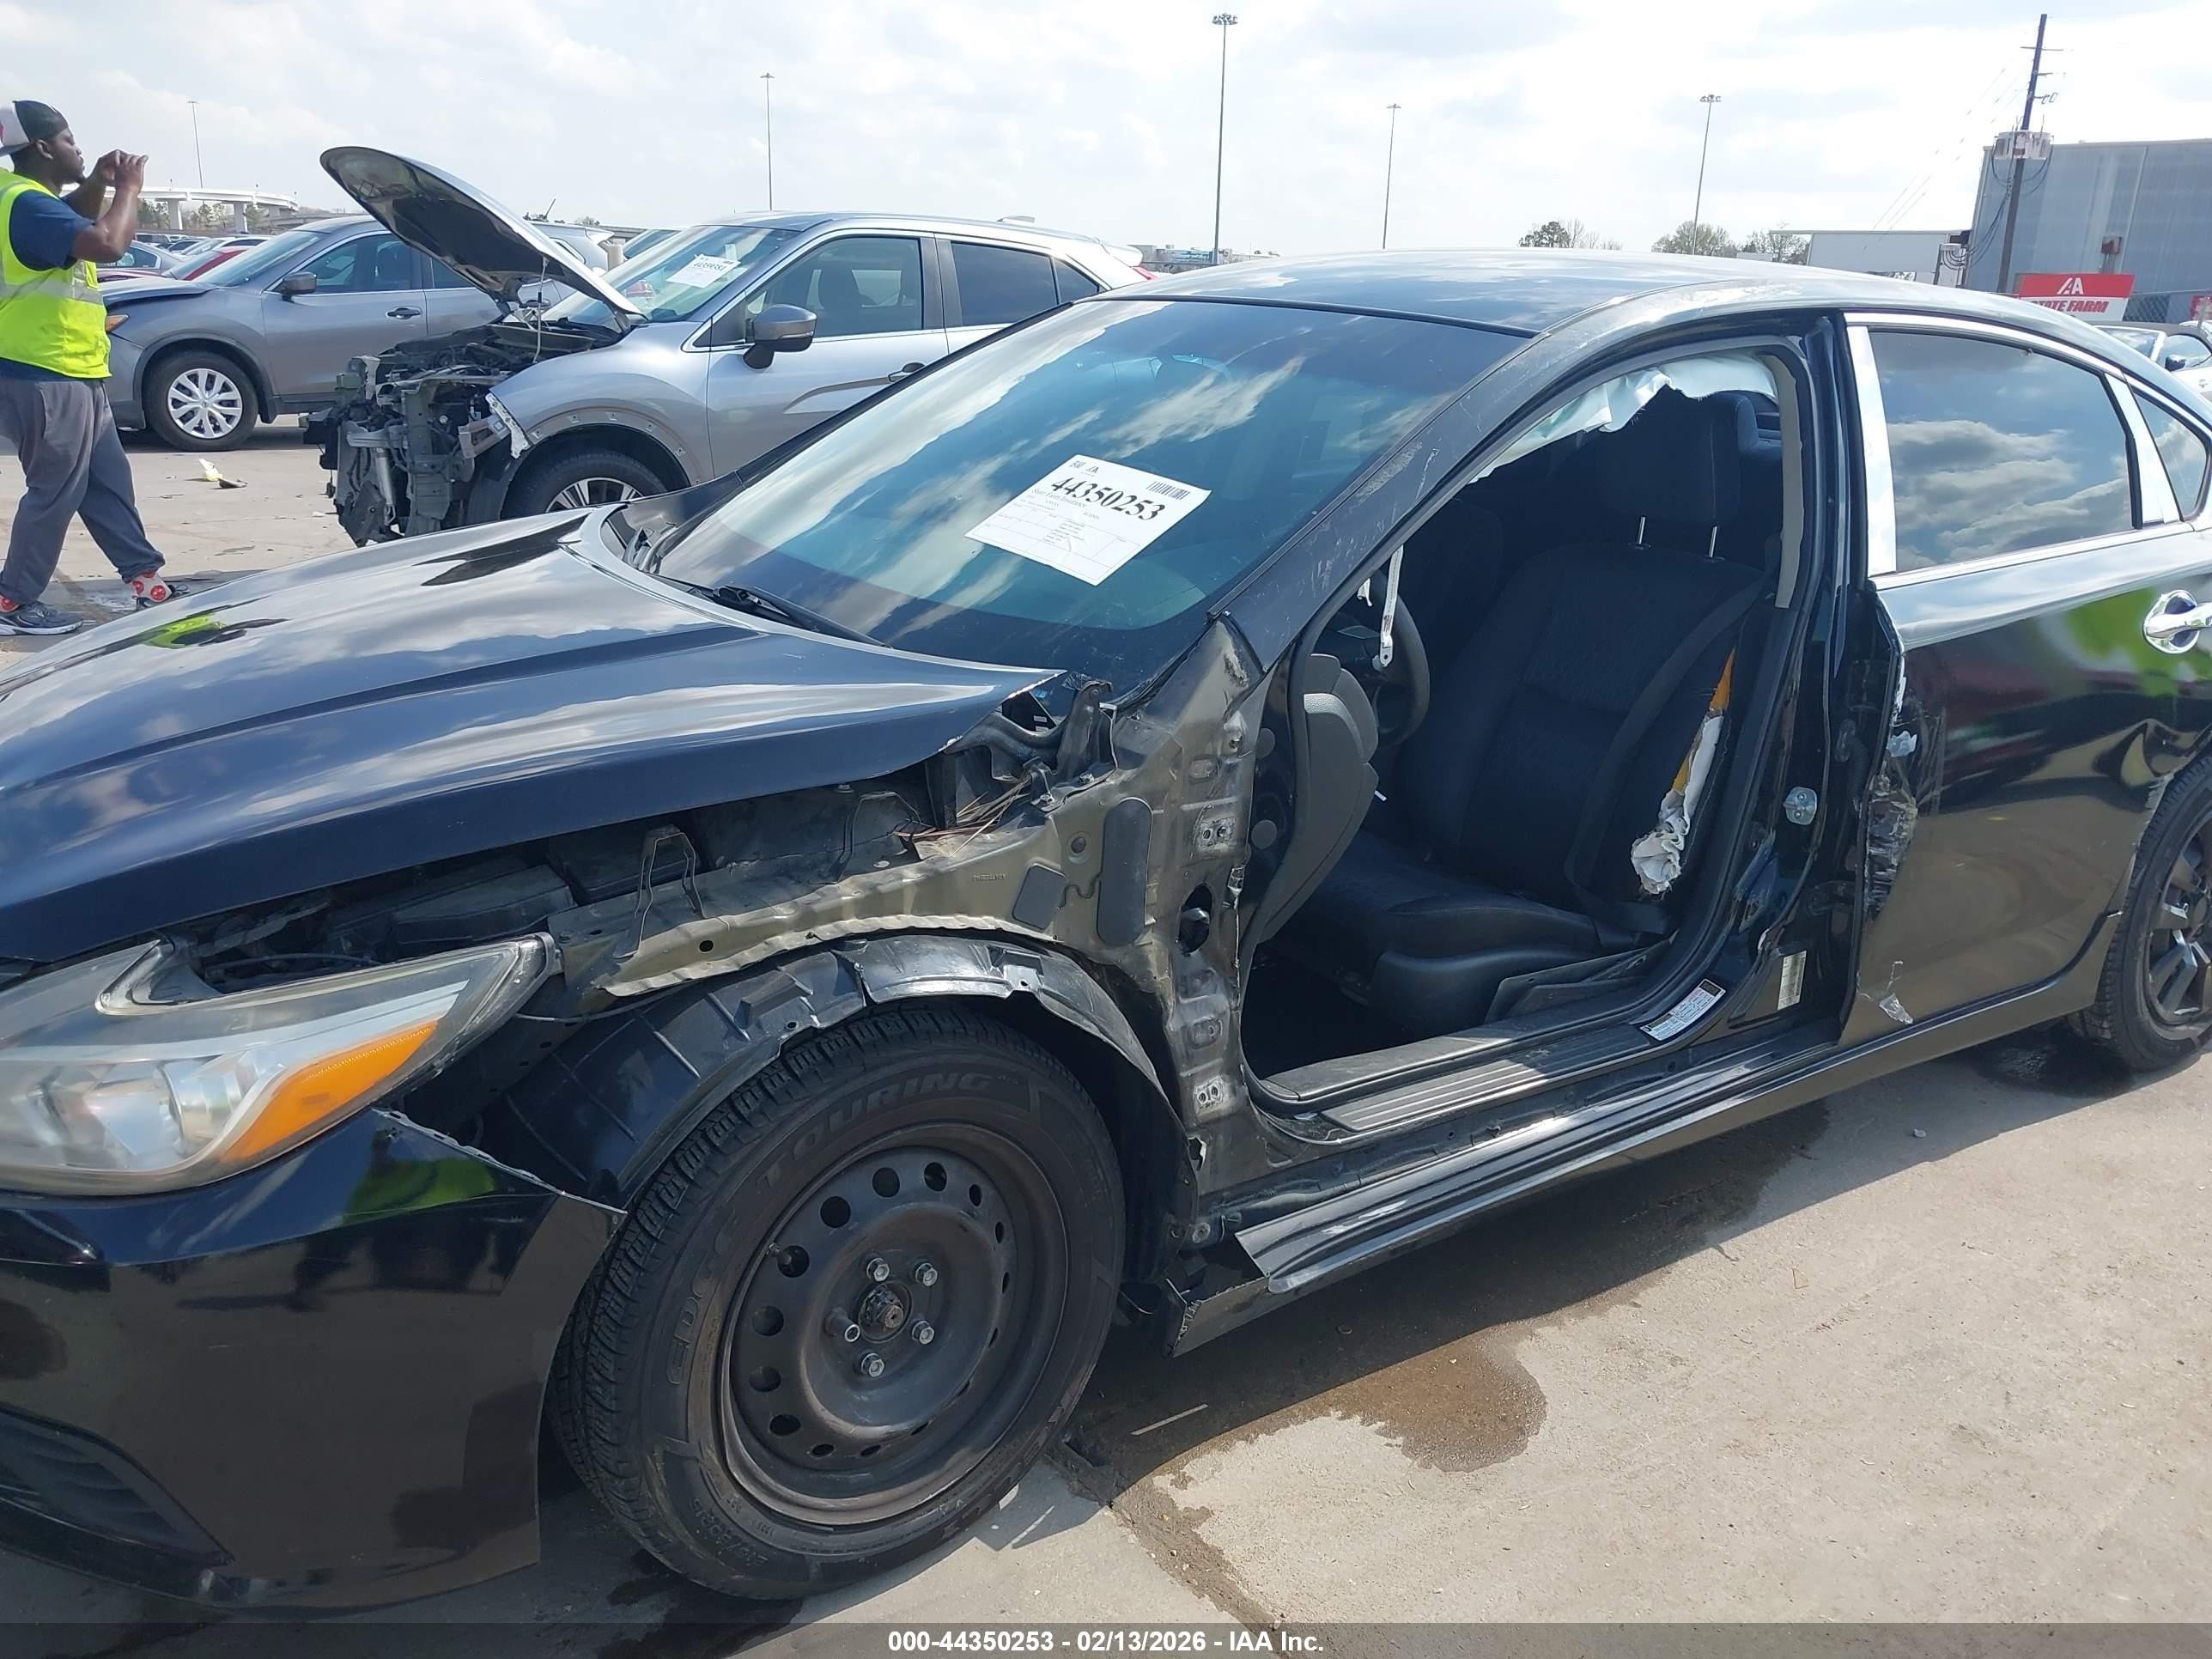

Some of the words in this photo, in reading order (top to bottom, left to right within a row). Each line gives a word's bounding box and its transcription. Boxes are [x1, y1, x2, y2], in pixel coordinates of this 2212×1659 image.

[2066, 300, 2110, 313] FARM
[1051, 477, 1166, 521] 44350253
[753, 1070, 994, 1194] TOURING
